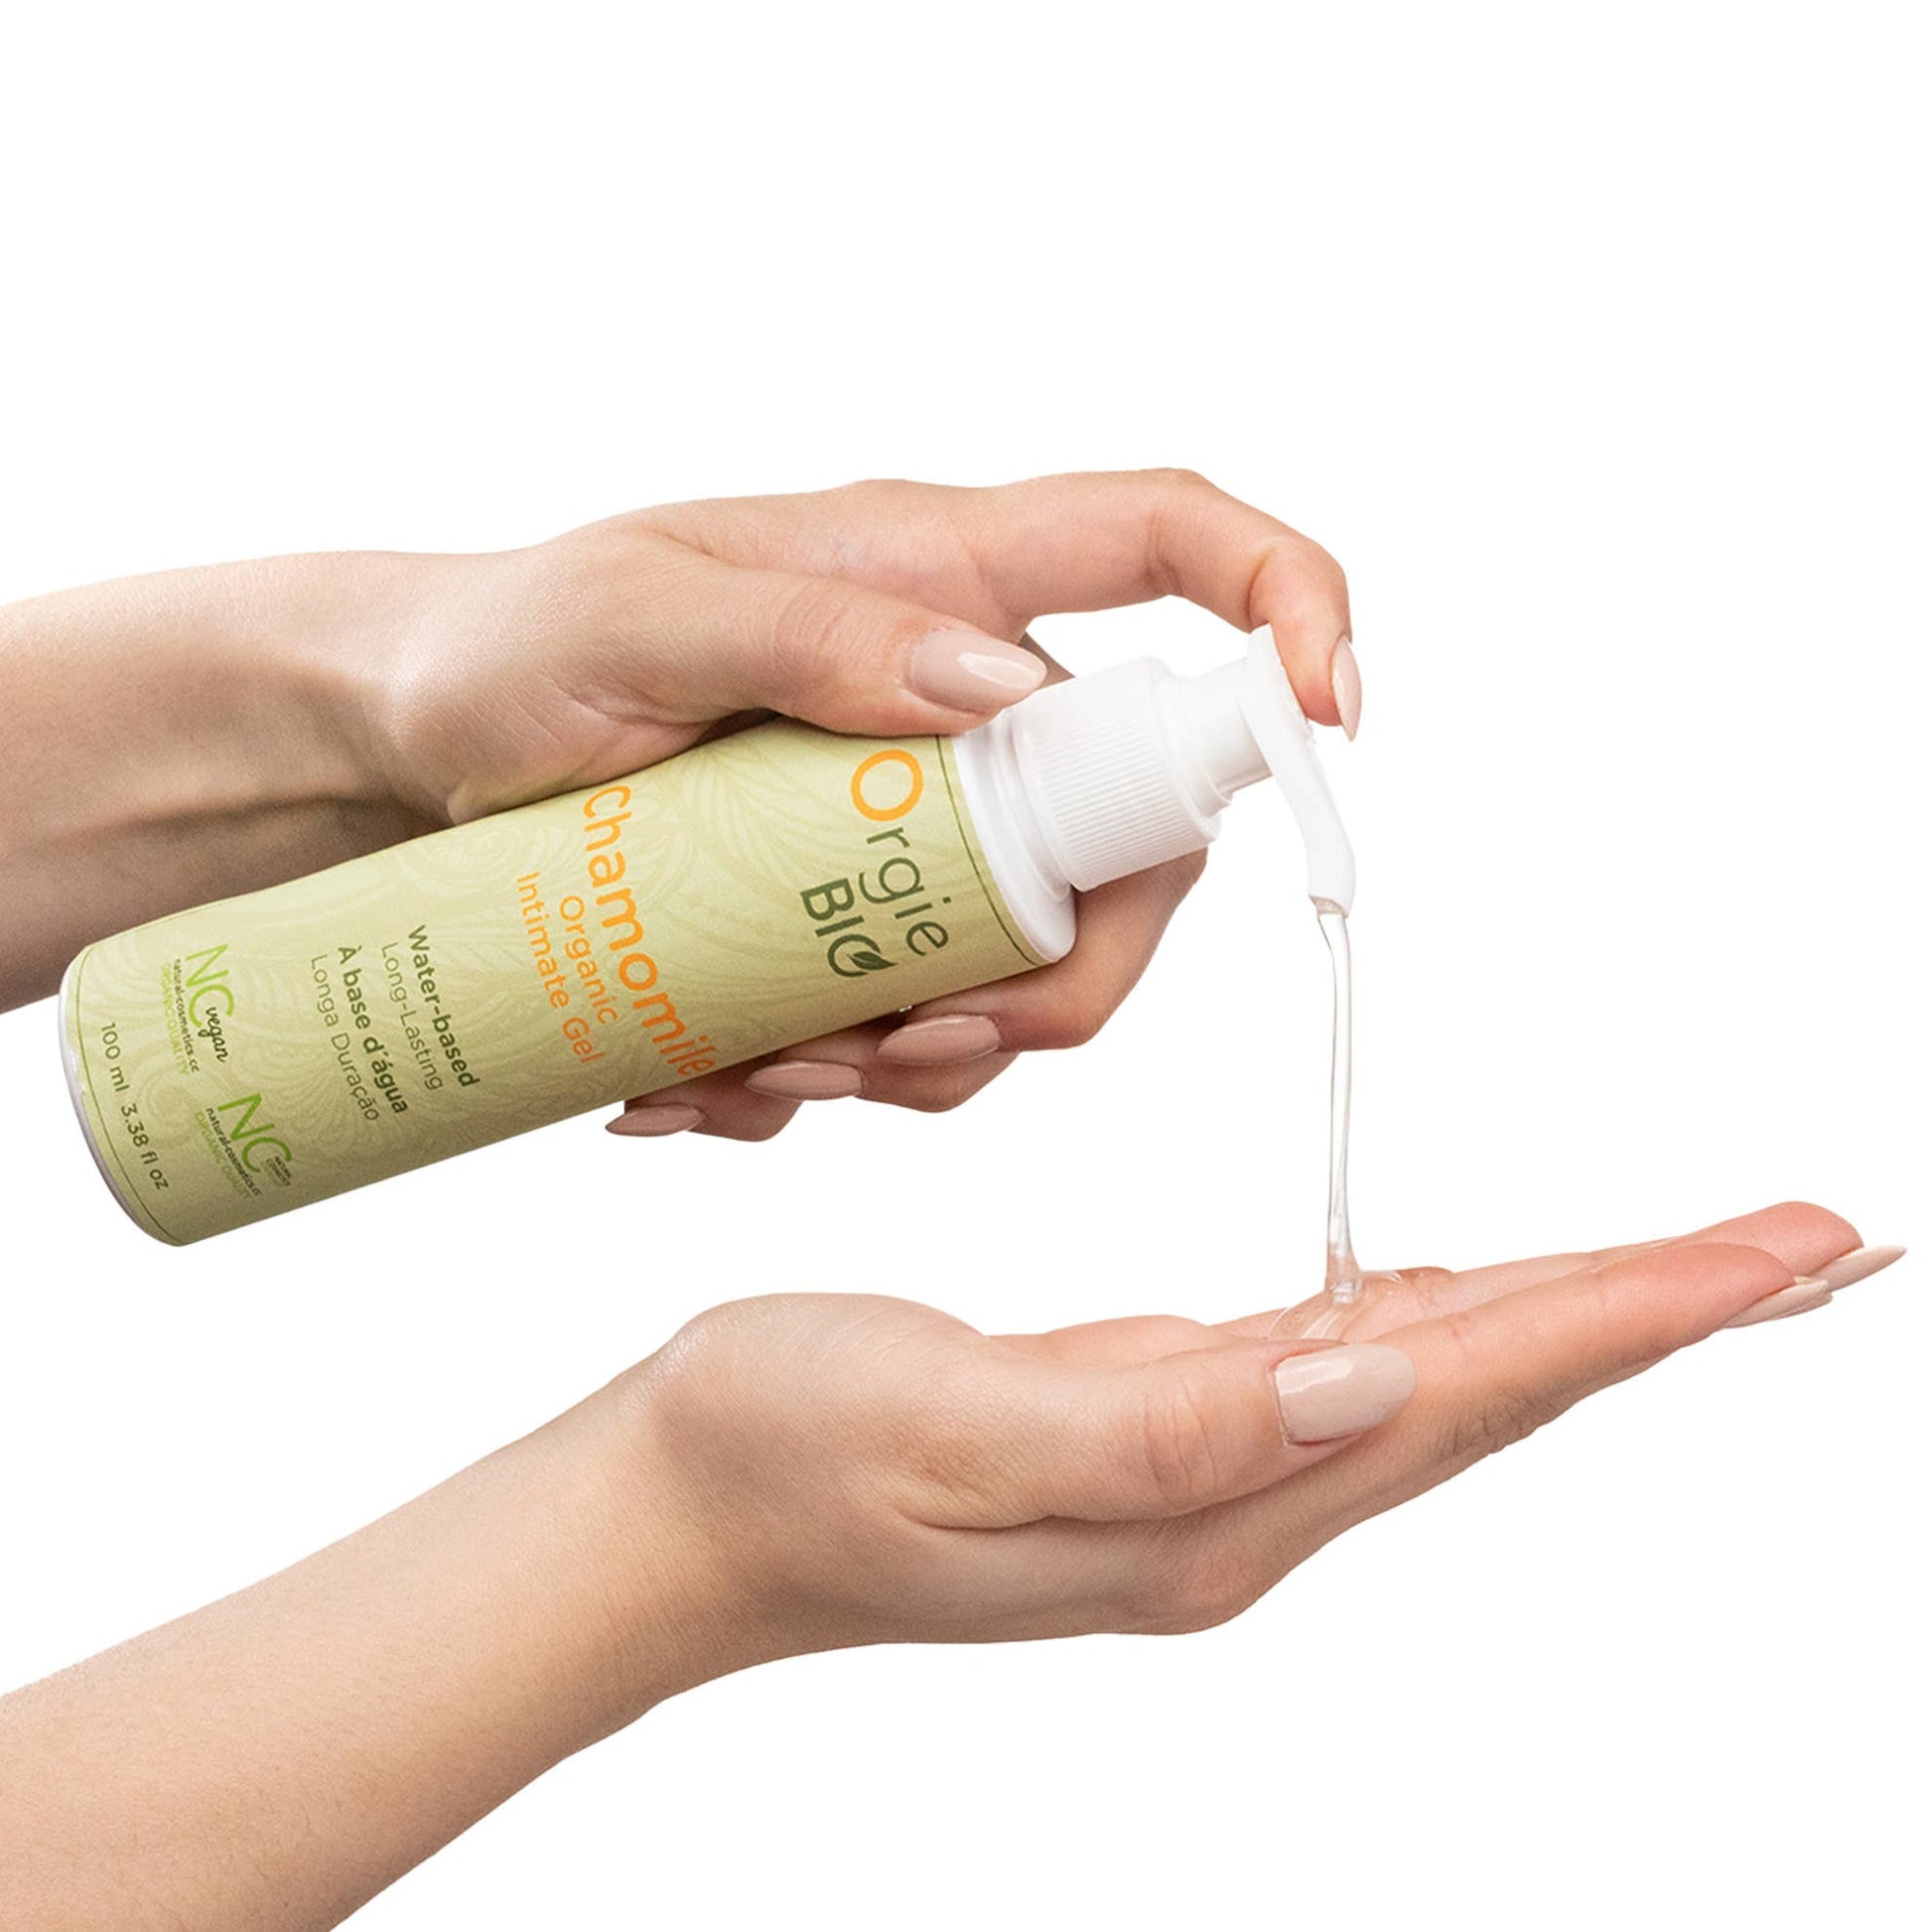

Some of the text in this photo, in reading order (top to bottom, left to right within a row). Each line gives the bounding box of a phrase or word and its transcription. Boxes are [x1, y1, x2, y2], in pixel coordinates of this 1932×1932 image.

[850, 749, 950, 956] Orgie
[186, 943, 234, 1028] NC
[338, 945, 362, 965] À
[517, 872, 604, 1063] Intimate Gel
[559, 896, 618, 1025] Organic
[583, 784, 716, 1075] Chamomile
[800, 878, 897, 978] BIO
[198, 1007, 228, 1063] vegan
[311, 954, 379, 1121] Longa Duração
[343, 968, 371, 1030] base
[381, 942, 444, 1091] Long-Lasting
[408, 924, 481, 1087] Water-based
[100, 1022, 169, 1190] 100 ml 3.38 fl oz
[217, 1093, 293, 1173] NC
